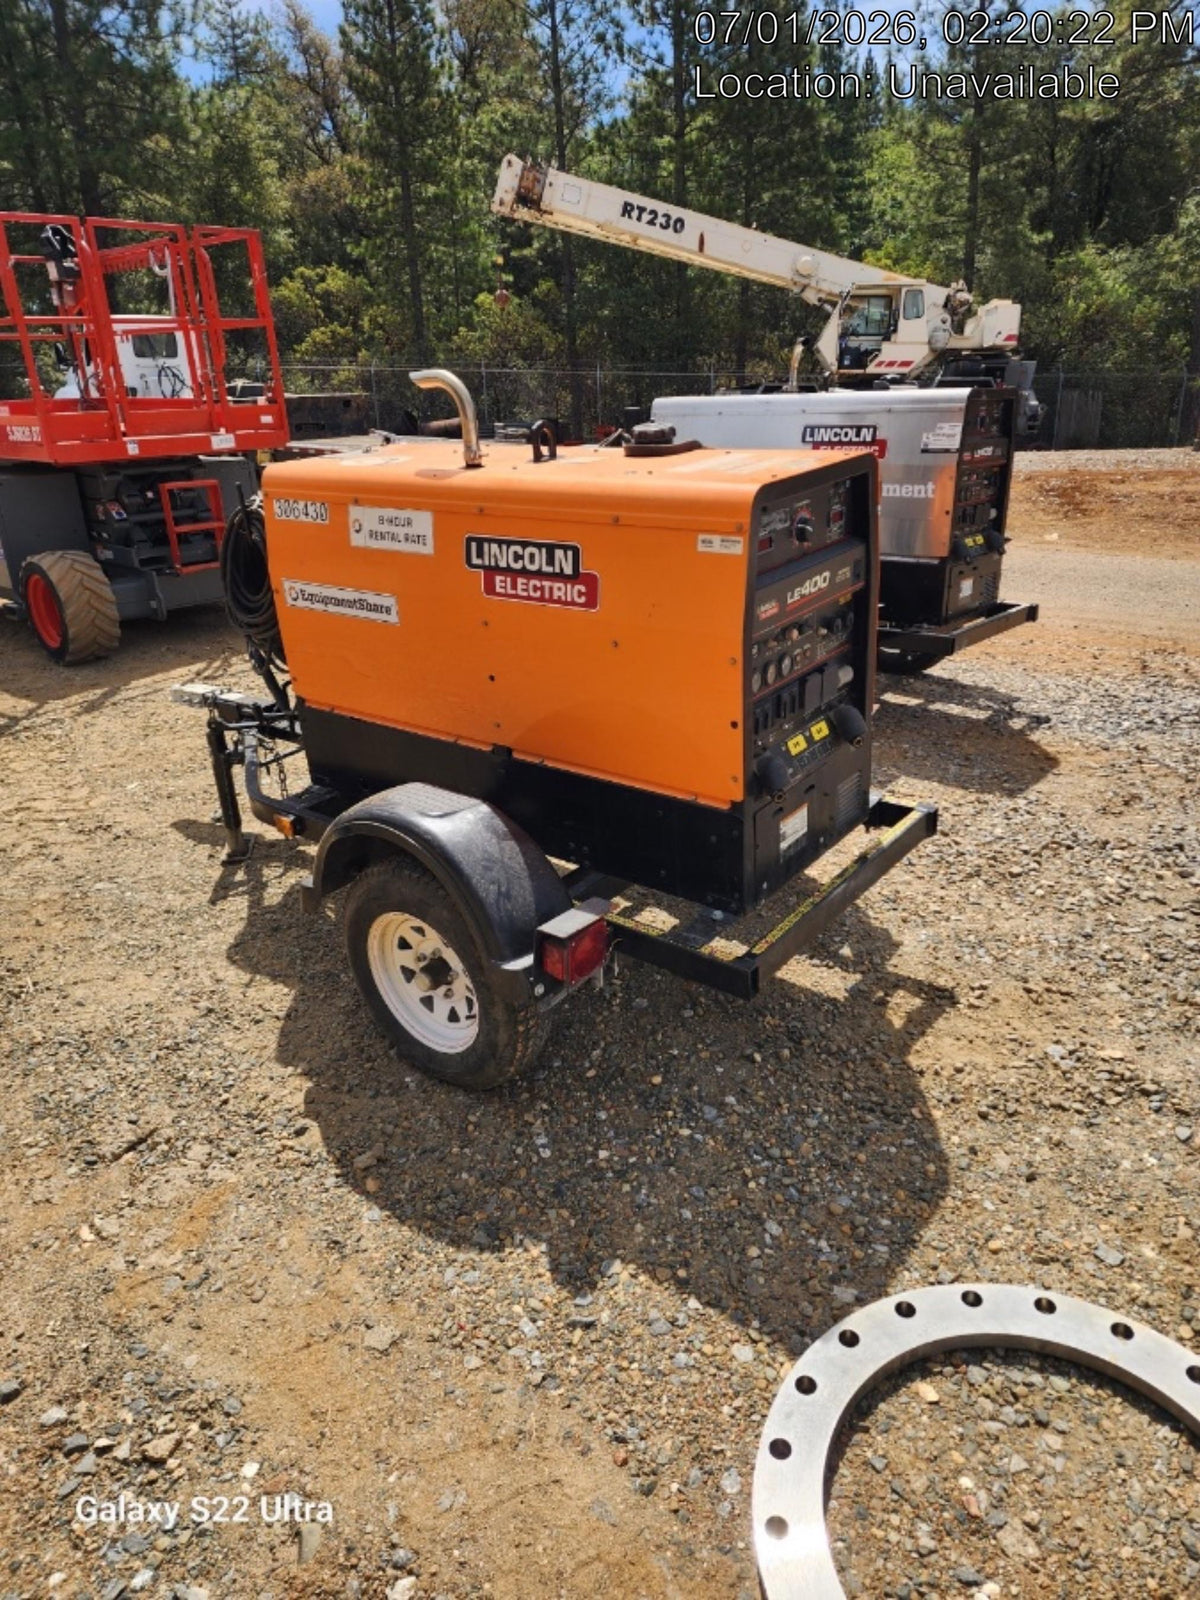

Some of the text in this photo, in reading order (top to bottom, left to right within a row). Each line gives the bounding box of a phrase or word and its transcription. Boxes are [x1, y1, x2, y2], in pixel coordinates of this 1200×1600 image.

[620, 201, 685, 234] RT230
[804, 427, 874, 442] LINCOLN
[275, 499, 329, 522] 306430
[368, 530, 428, 547] RENTAL RATE
[470, 541, 573, 575] LINCOLN
[495, 575, 587, 604] ELECTRIC
[786, 570, 831, 604] LE400
[300, 589, 393, 615] EquipmentShare
